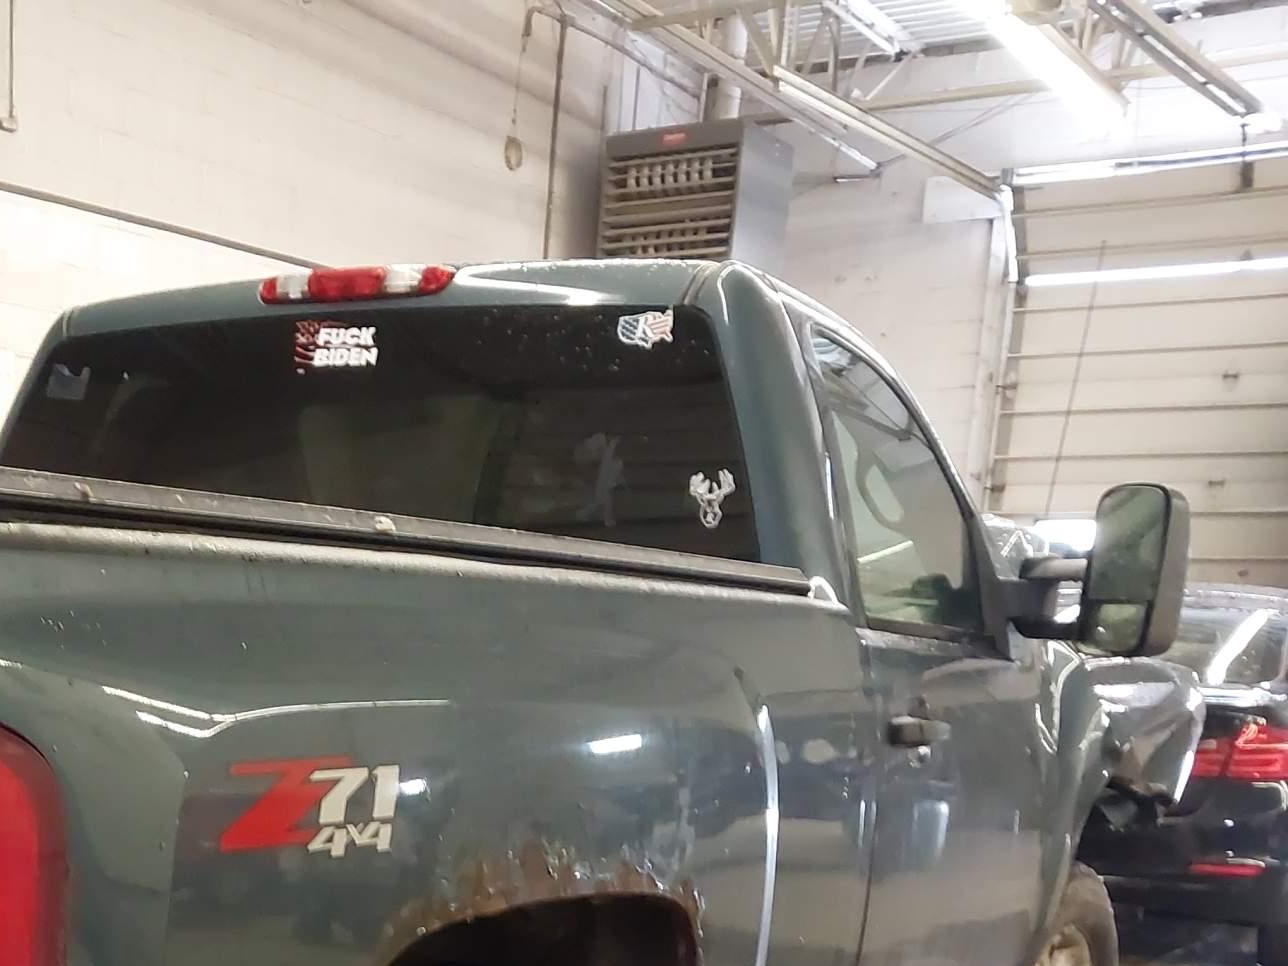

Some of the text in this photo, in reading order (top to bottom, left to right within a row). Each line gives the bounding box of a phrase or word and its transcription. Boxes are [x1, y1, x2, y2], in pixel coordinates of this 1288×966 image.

[316, 326, 377, 347] FUCK
[312, 346, 379, 368] BIDEN
[219, 755, 401, 854] Z71
